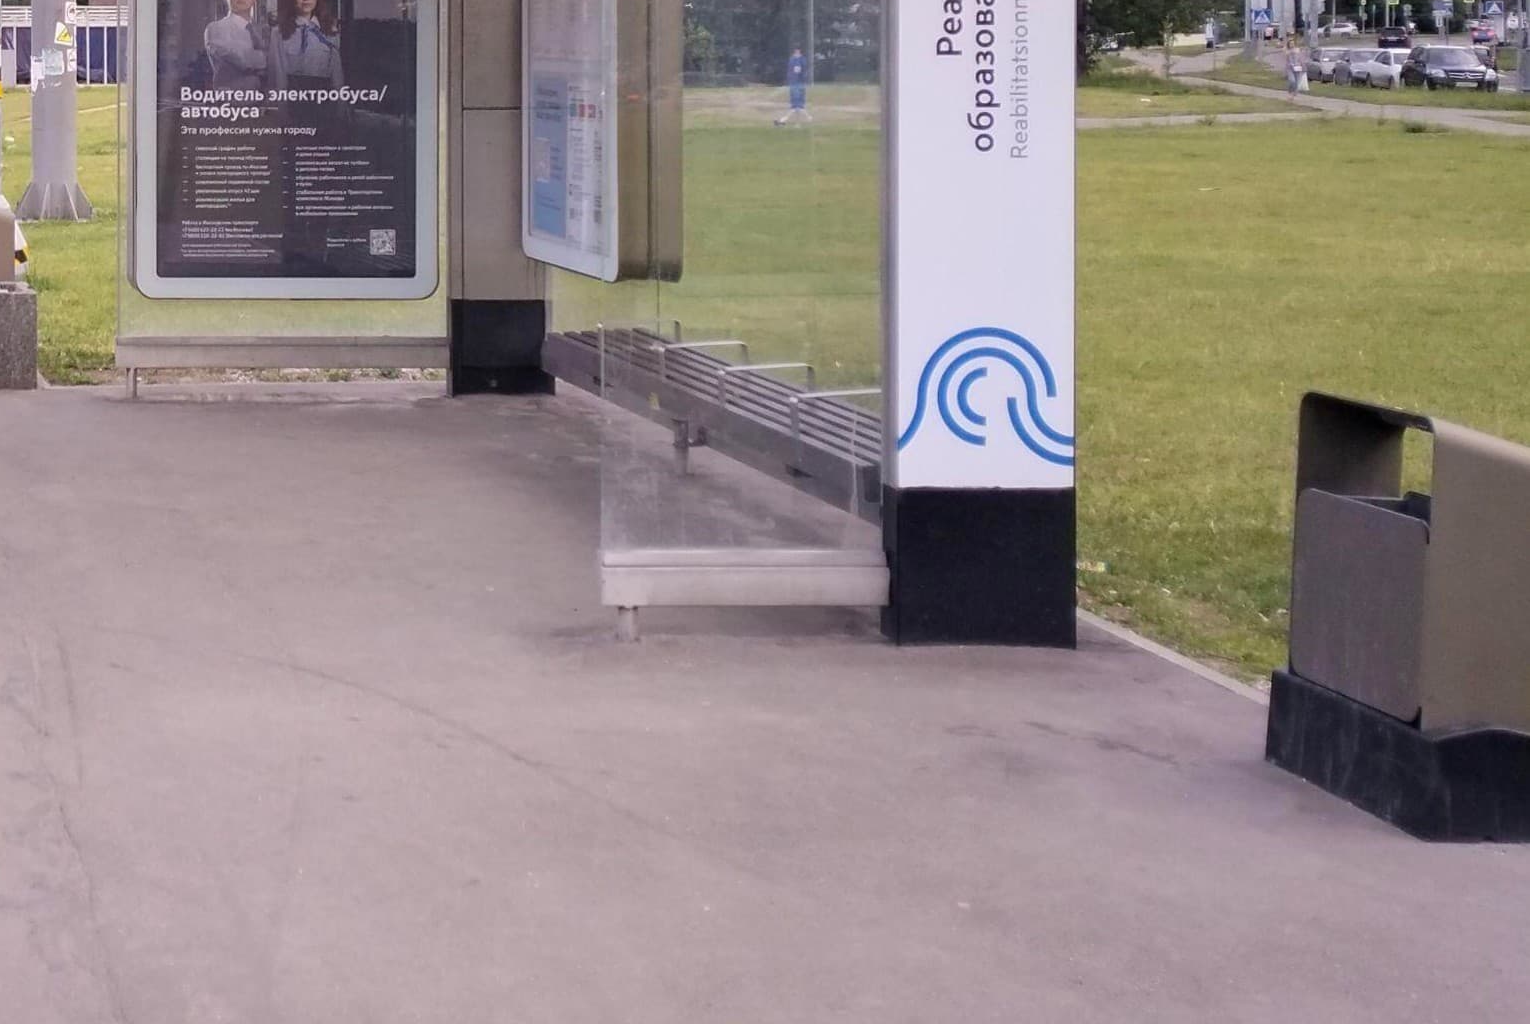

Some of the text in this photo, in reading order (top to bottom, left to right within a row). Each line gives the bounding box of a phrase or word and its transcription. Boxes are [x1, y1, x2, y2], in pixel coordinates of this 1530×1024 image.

[180, 85, 388, 104] Водитель электробуса/
[181, 104, 260, 121] автобуса
[181, 126, 316, 137] Эта профессия нужна городу
